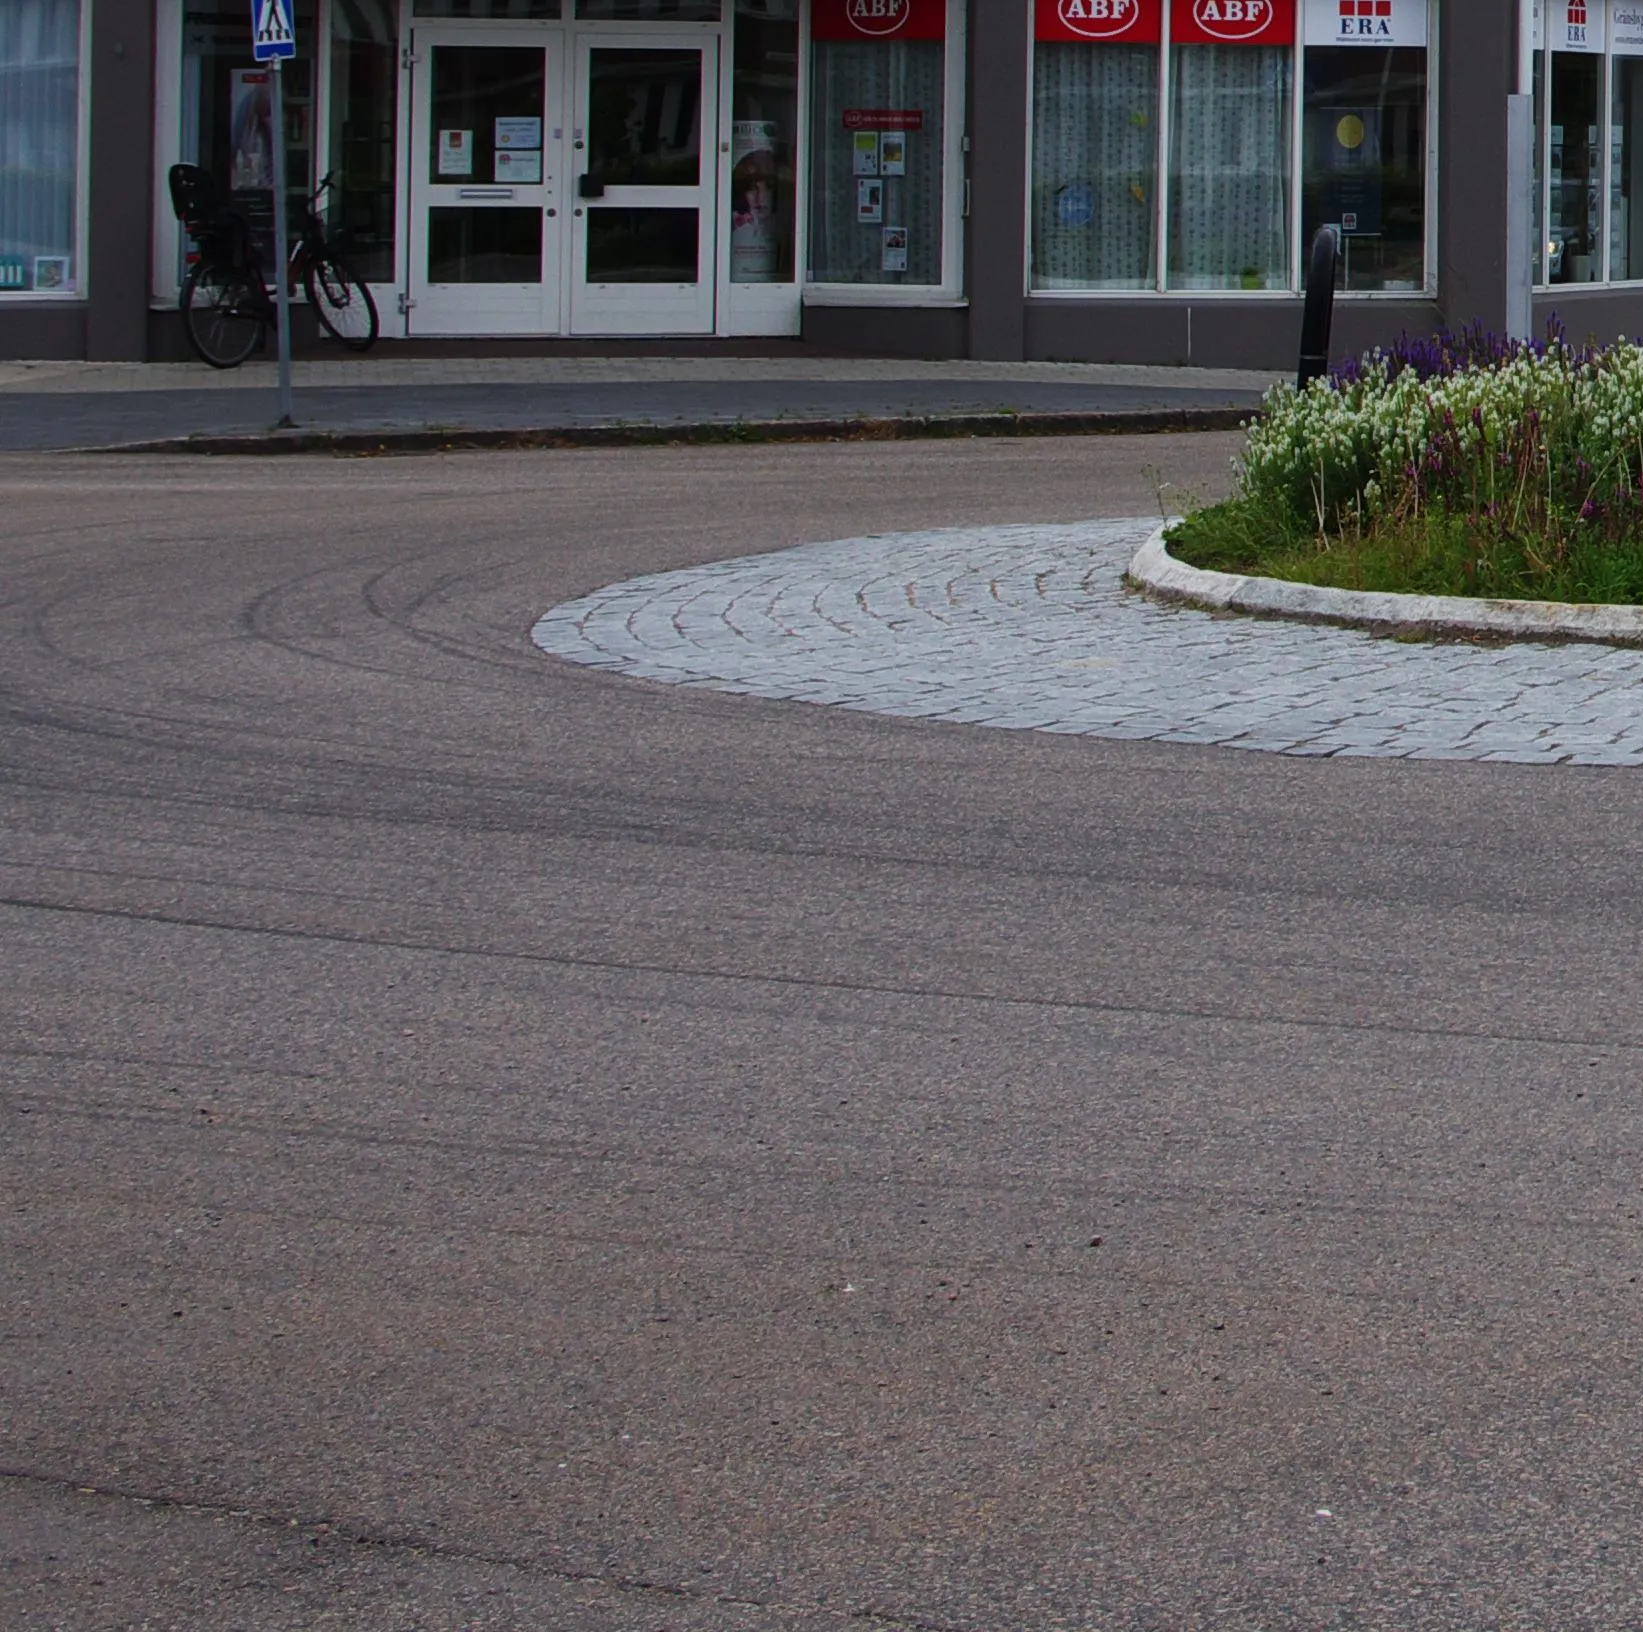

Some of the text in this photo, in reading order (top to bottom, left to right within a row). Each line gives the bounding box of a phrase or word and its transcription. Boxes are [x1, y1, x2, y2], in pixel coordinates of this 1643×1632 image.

[1201, 0, 1264, 21] ABF
[1340, 18, 1391, 35] ERA
[1567, 25, 1586, 42] ERA
